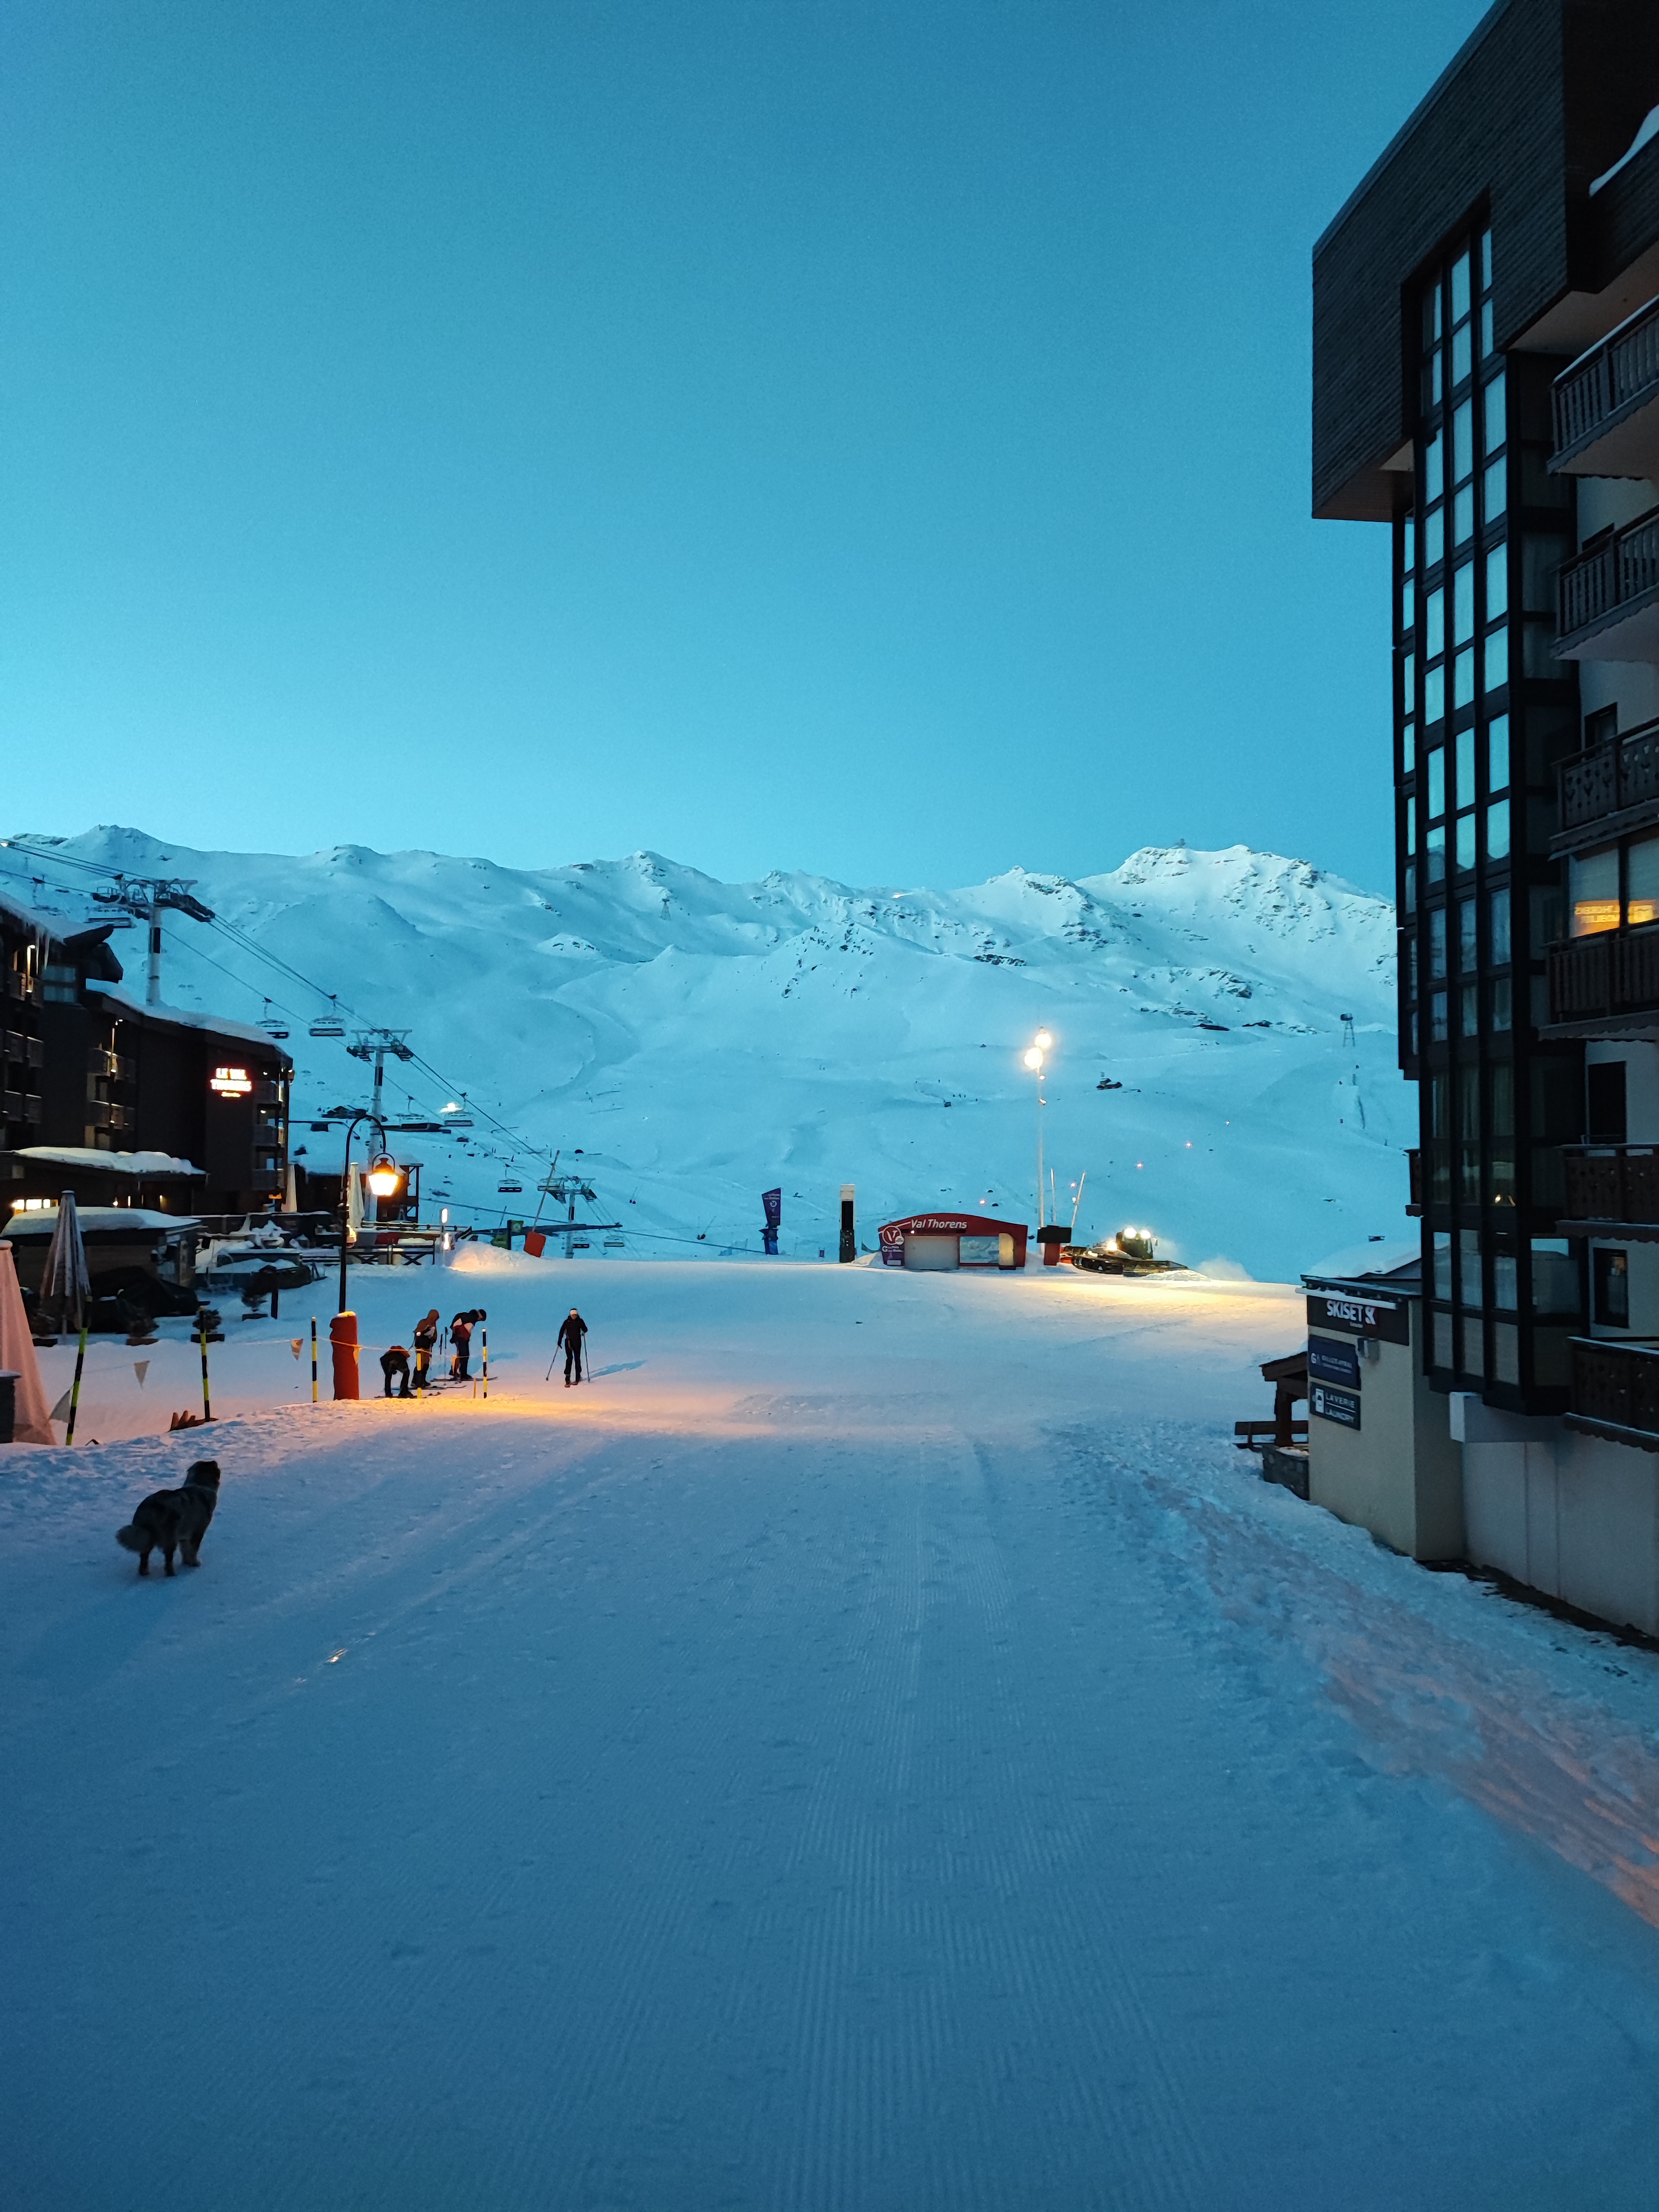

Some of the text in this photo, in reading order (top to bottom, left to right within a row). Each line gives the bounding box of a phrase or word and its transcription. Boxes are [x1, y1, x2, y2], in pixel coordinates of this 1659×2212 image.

[911, 1219, 968, 1229] Val Thorens
[1327, 1300, 1363, 1322] SKISET
